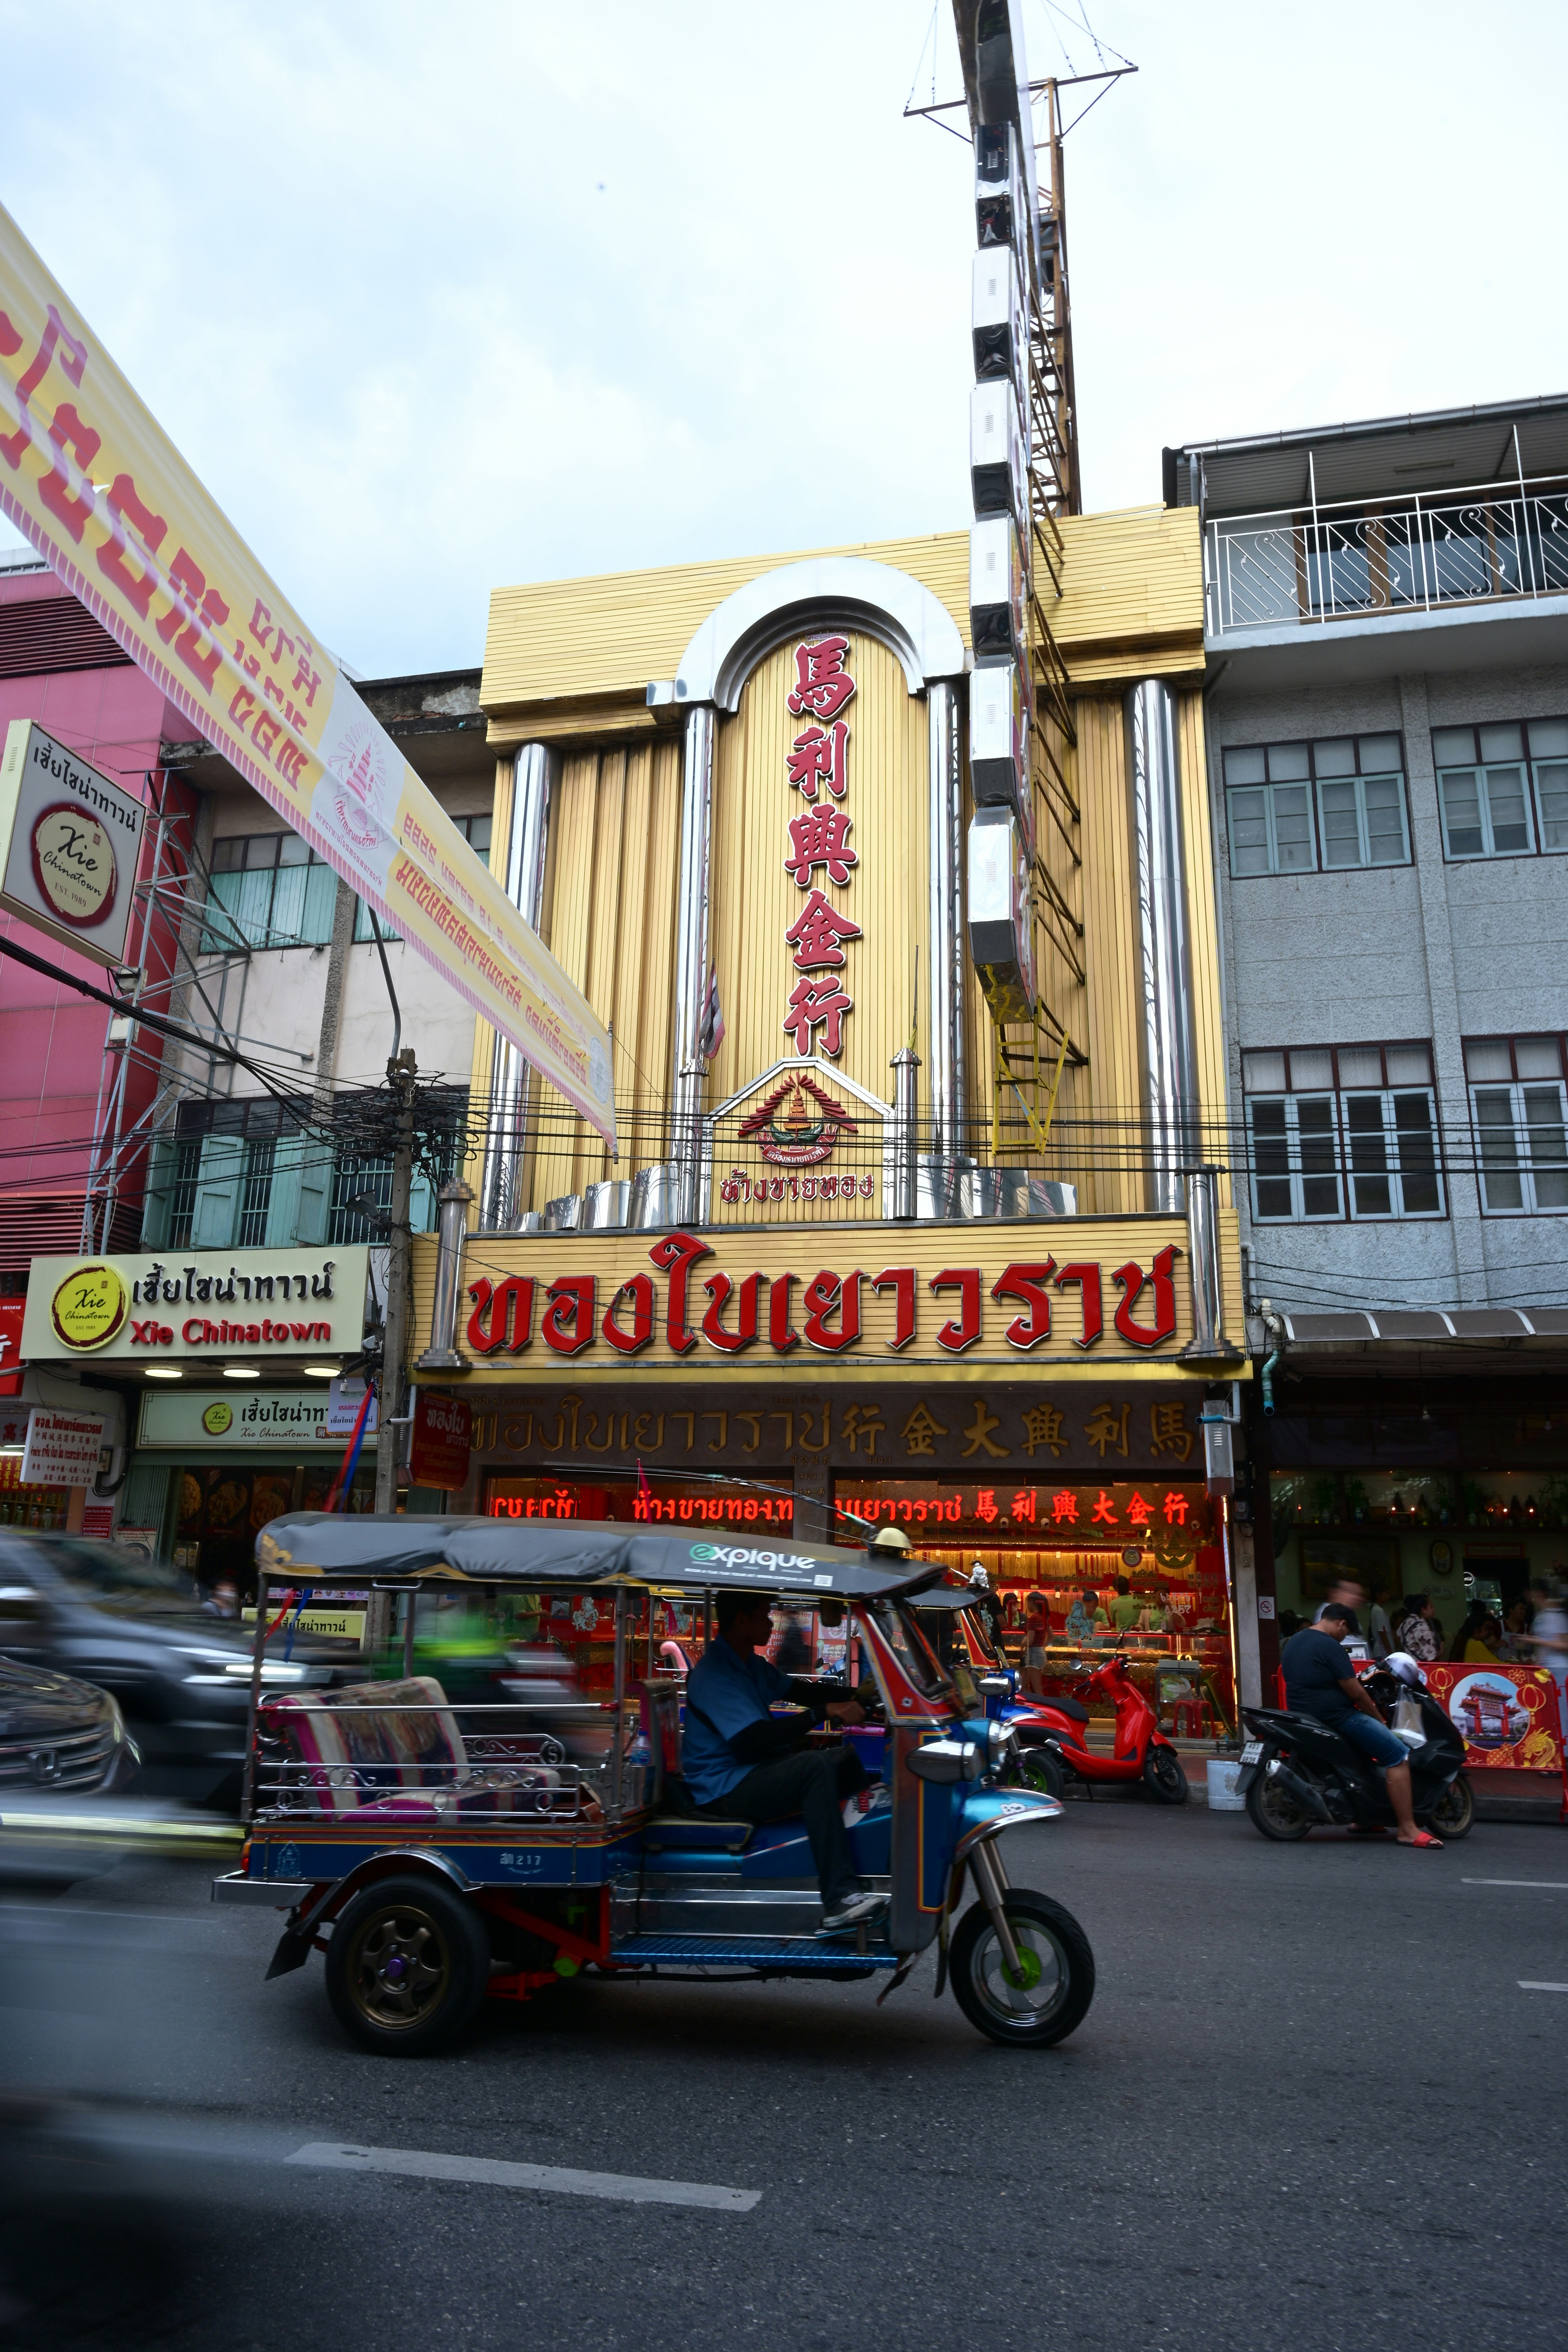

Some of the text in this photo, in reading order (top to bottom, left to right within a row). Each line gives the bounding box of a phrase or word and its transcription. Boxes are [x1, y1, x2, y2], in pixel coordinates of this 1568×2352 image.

[58, 825, 98, 872] Xie
[783, 635, 863, 1057] 馬利興金行
[43, 851, 102, 896] Chinatown
[55, 882, 87, 908] EST. 1989
[720, 1168, 874, 1204] ห้างขายทอง
[132, 1262, 336, 1304] เซี้ยไชน่าทาวน์
[466, 1230, 1183, 1355] ทองใบเยาวราช
[74, 1289, 106, 1309] Xie
[65, 1311, 110, 1321] Chinatown
[130, 1318, 331, 1344] Xie Chinatown
[212, 1412, 226, 1420] Xie
[242, 1397, 328, 1422] เซี้ยไชน่าท
[427, 1402, 465, 1435] ทองใบ
[241, 1428, 310, 1438] Xie Chinatown
[689, 1543, 817, 1571] expique
